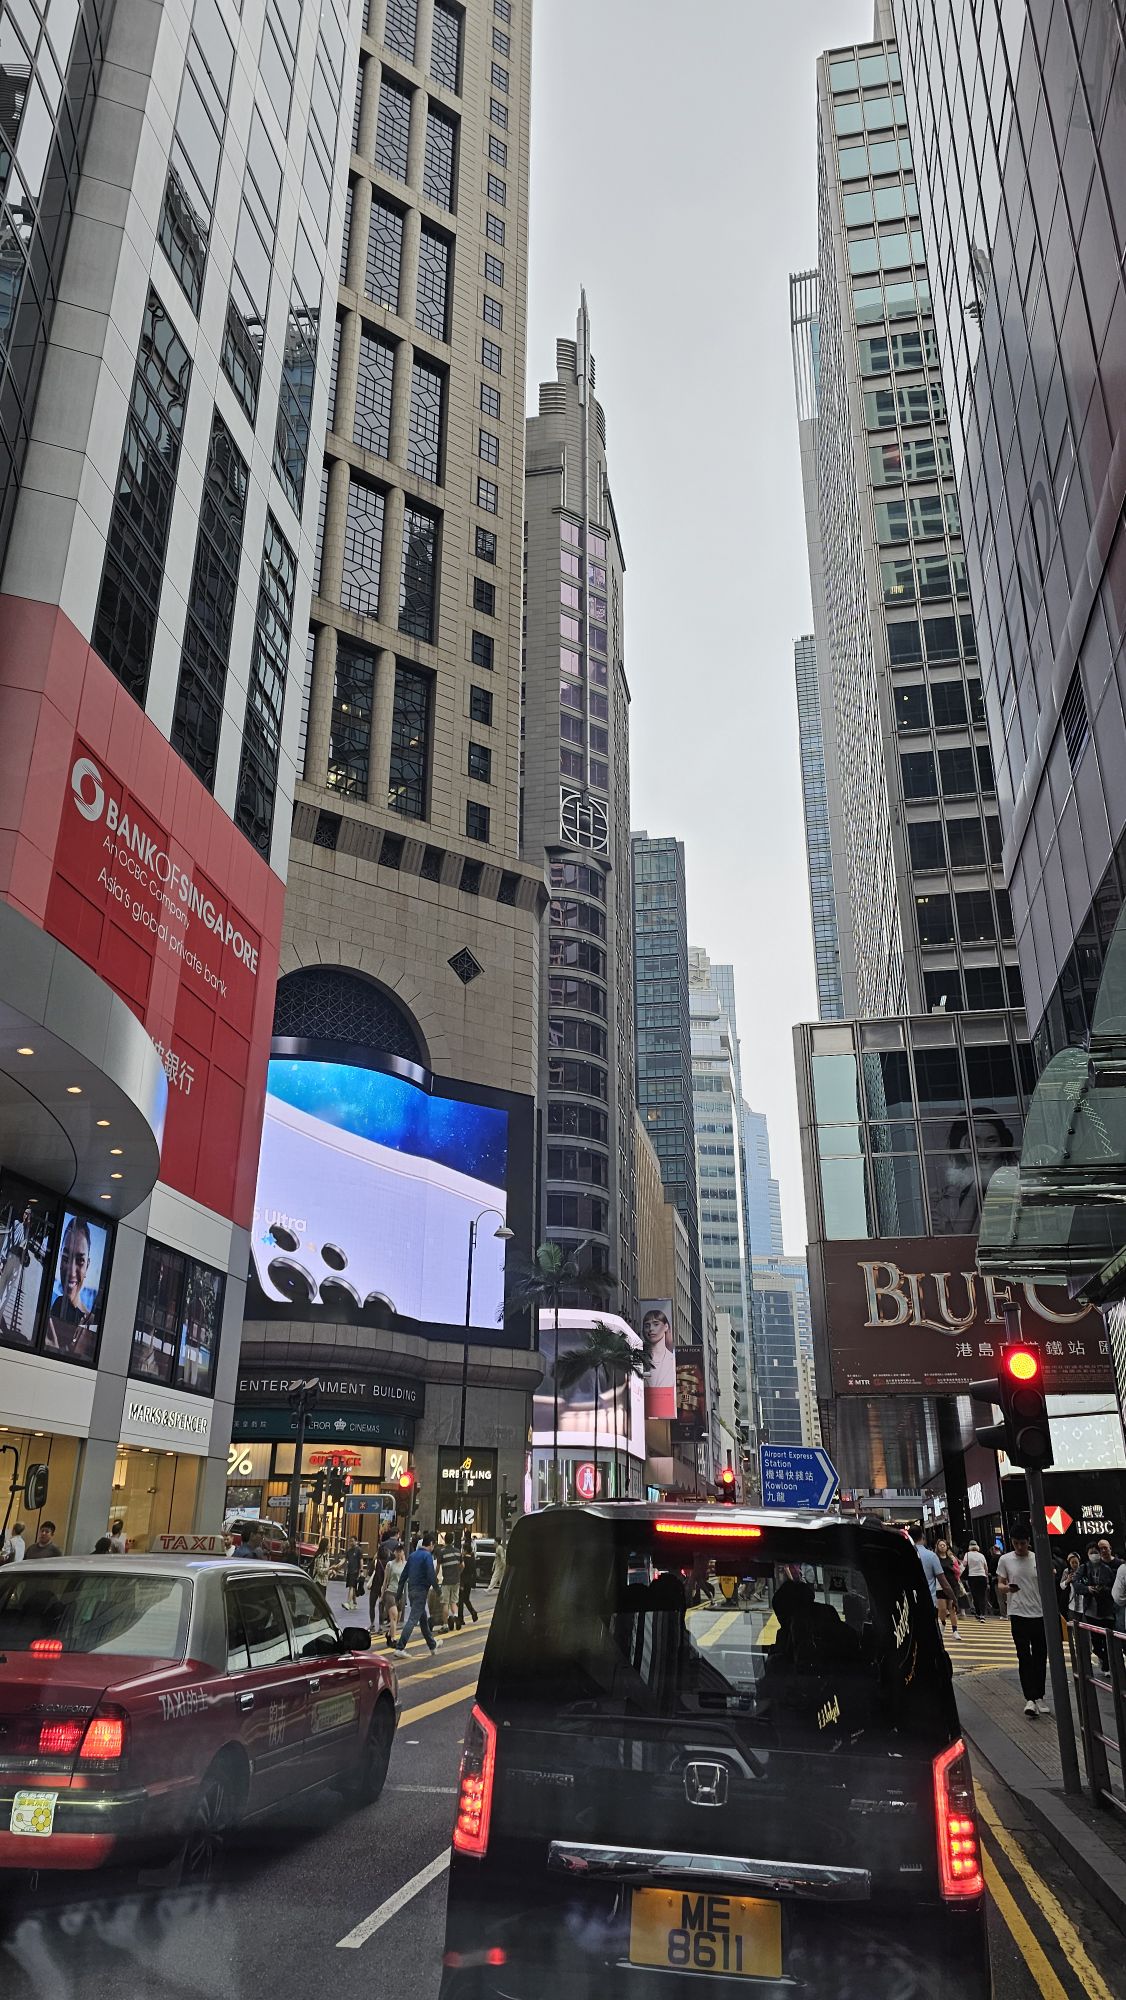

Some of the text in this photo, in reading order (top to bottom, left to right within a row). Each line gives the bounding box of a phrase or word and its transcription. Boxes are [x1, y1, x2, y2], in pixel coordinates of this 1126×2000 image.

[103, 836, 190, 930] An OCBC Company
[106, 798, 259, 975] BANK OF SINGAPORE
[97, 867, 227, 998] Asia's global private bank
[265, 1209, 307, 1232] Ultra
[372, 1384, 417, 1402] BUILDING
[349, 1422, 380, 1433] CINEMAS
[764, 1450, 813, 1460] Airport Express
[764, 1459, 792, 1468] Station
[765, 1481, 798, 1491] Kowloon
[767, 1491, 786, 1503] 九龍
[1075, 1520, 1114, 1535] HSBC
[160, 1535, 216, 1551] TAXI
[269, 1699, 286, 1722] 的士
[268, 1719, 286, 1746] TAXI
[681, 1894, 730, 1933] ME
[667, 1928, 743, 1972] 8611
